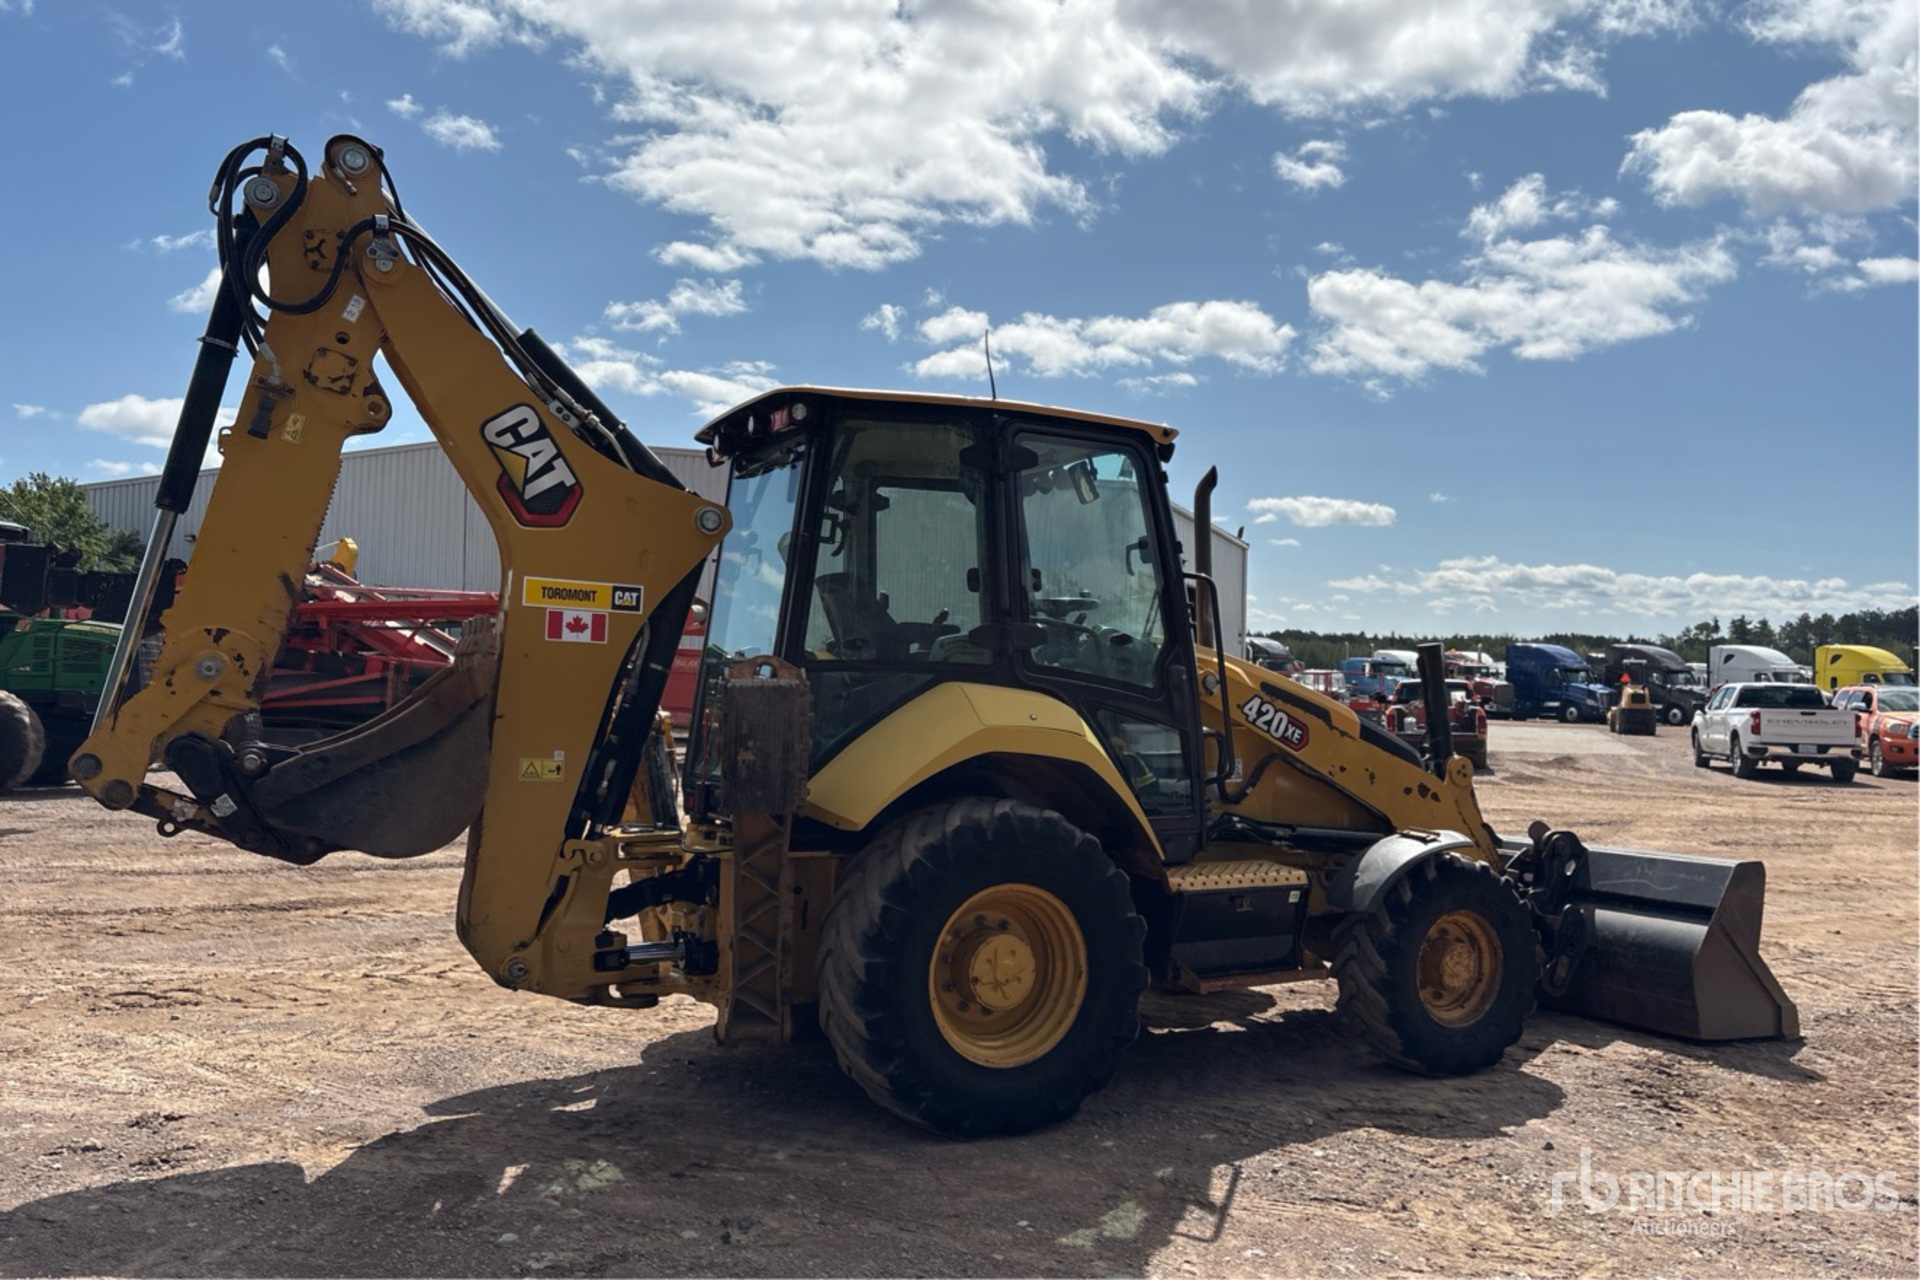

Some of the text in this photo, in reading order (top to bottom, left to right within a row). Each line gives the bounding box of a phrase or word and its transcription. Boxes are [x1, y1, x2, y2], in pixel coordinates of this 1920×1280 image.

[484, 405, 577, 500] CAT
[541, 586, 640, 606] TOROMONT CAT
